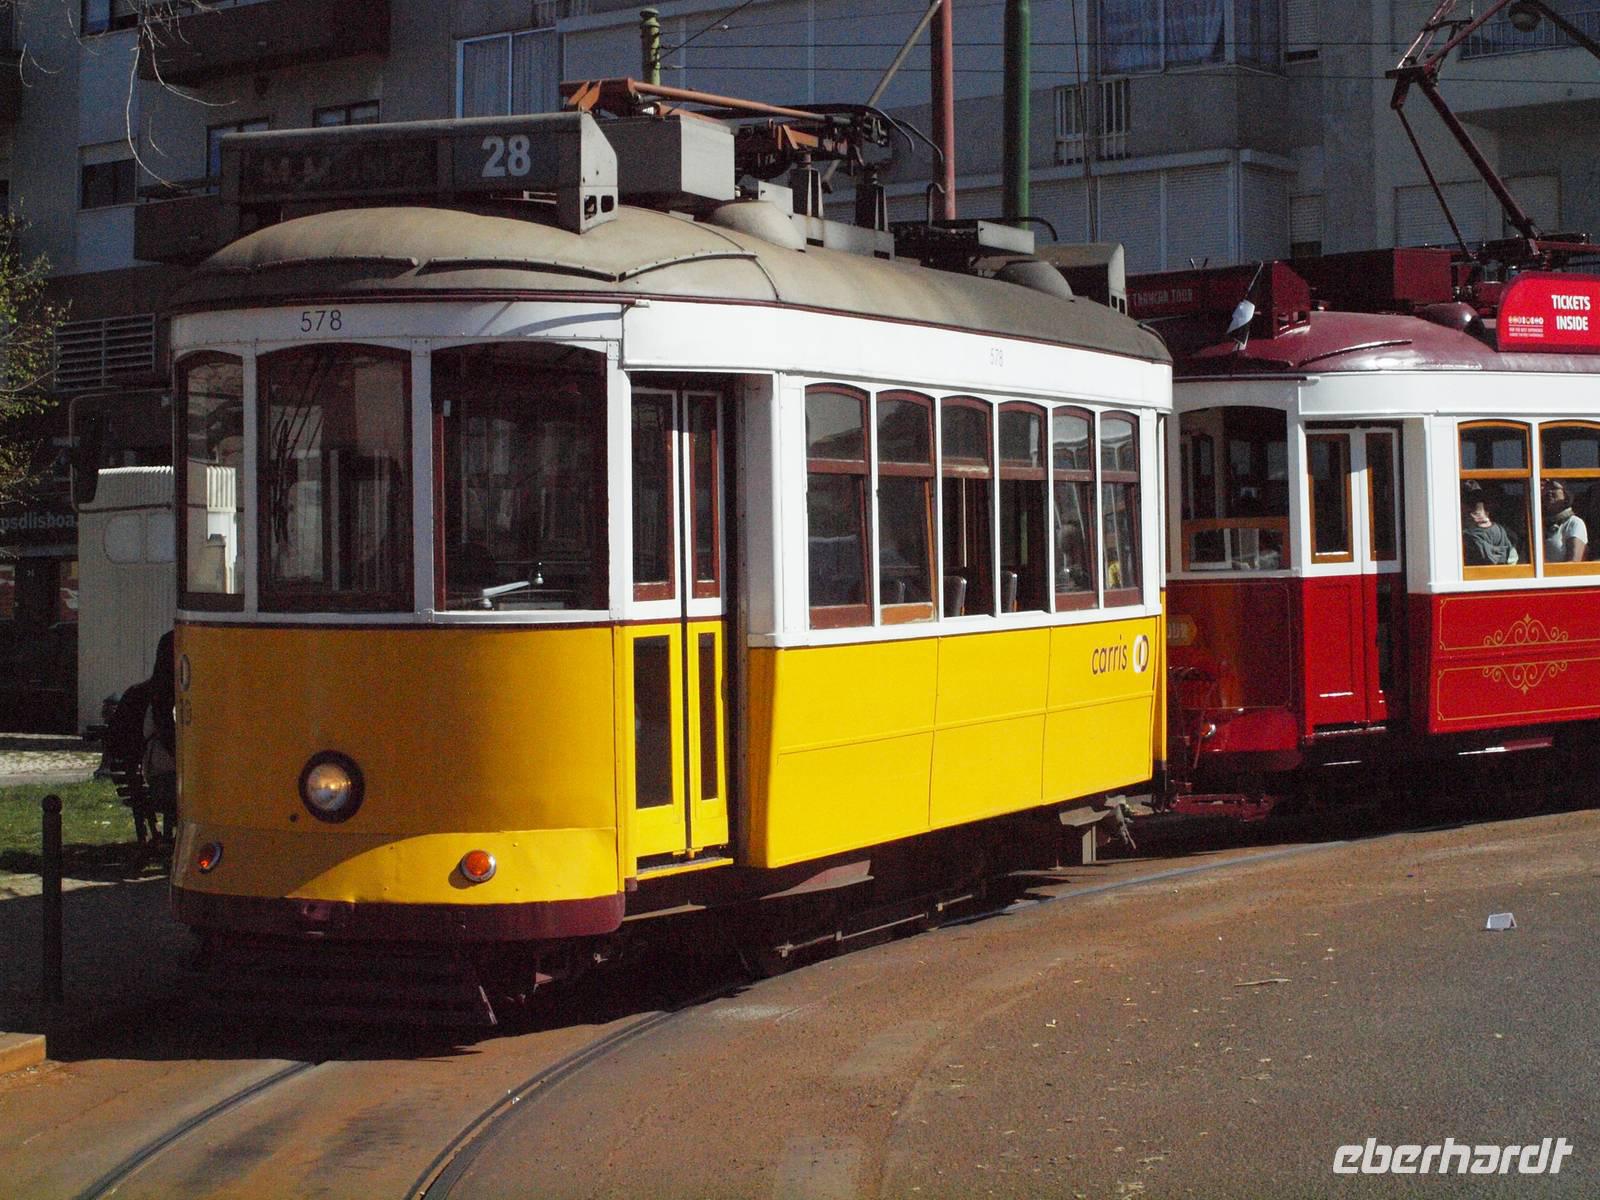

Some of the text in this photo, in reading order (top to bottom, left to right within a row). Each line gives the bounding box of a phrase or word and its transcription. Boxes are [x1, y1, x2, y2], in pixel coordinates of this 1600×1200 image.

[481, 135, 531, 177] 28
[1551, 295, 1591, 310] TICKETS
[301, 310, 342, 332] 578
[1556, 316, 1588, 331] INSIDE
[990, 348, 1004, 367] 578
[1091, 634, 1127, 675] carris
